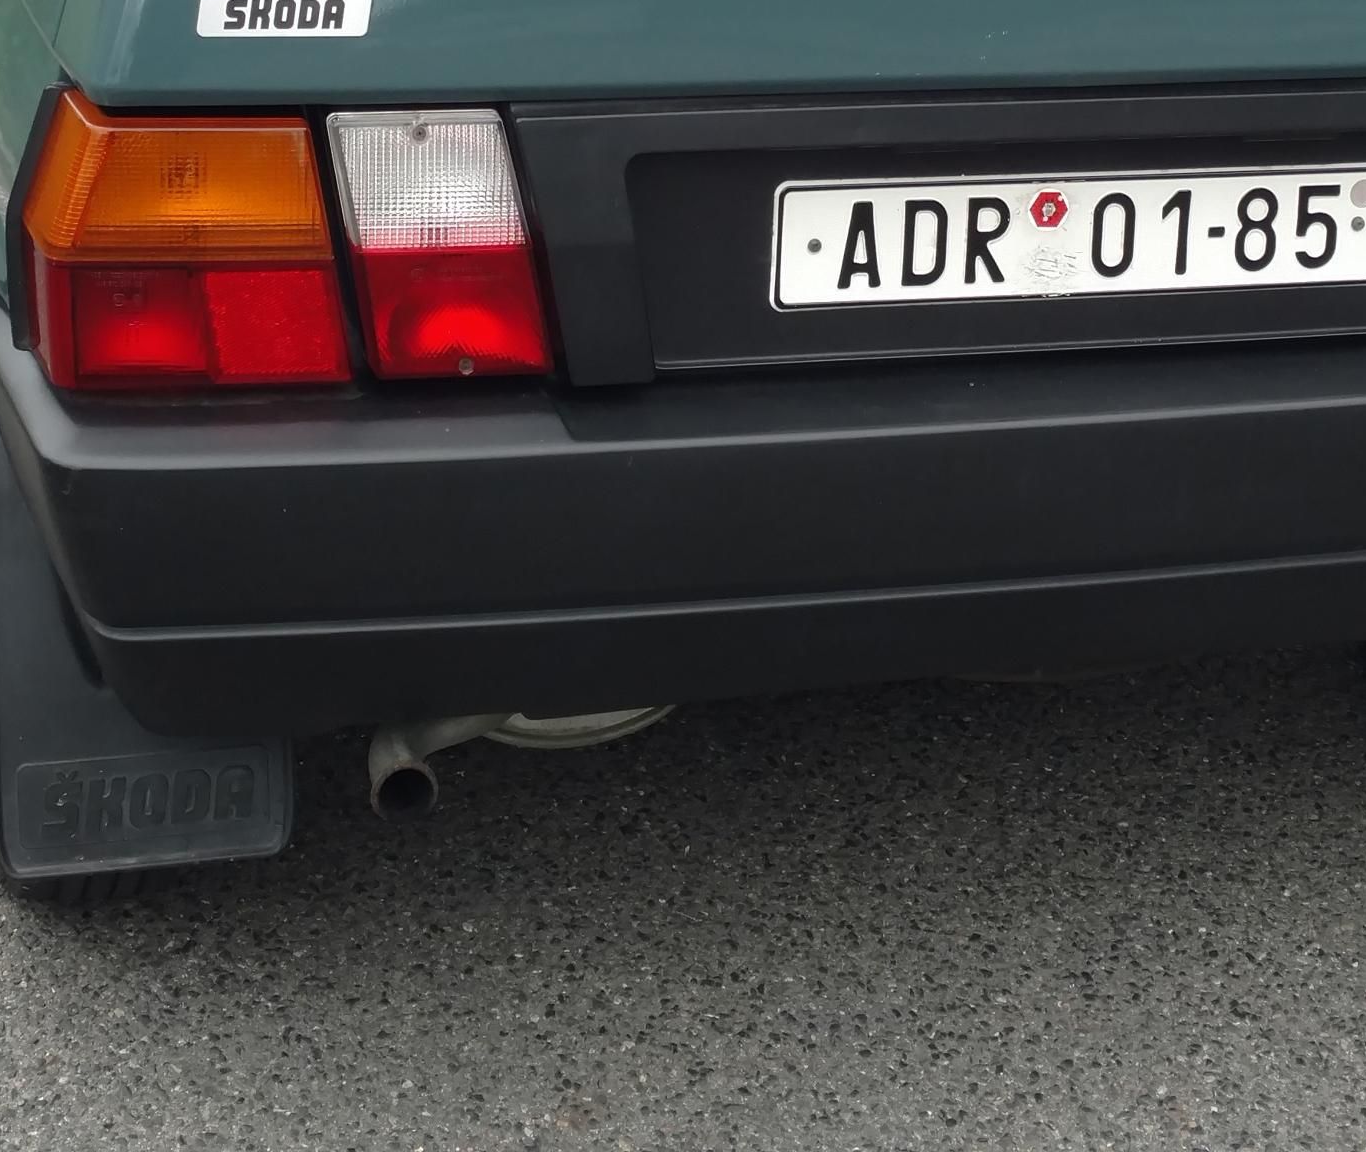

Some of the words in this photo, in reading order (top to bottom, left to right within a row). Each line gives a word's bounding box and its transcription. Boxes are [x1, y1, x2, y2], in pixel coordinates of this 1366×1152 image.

[836, 196, 1011, 290] ADR
[1090, 184, 1341, 278] 01-85
[41, 765, 255, 838] ŠKODA
